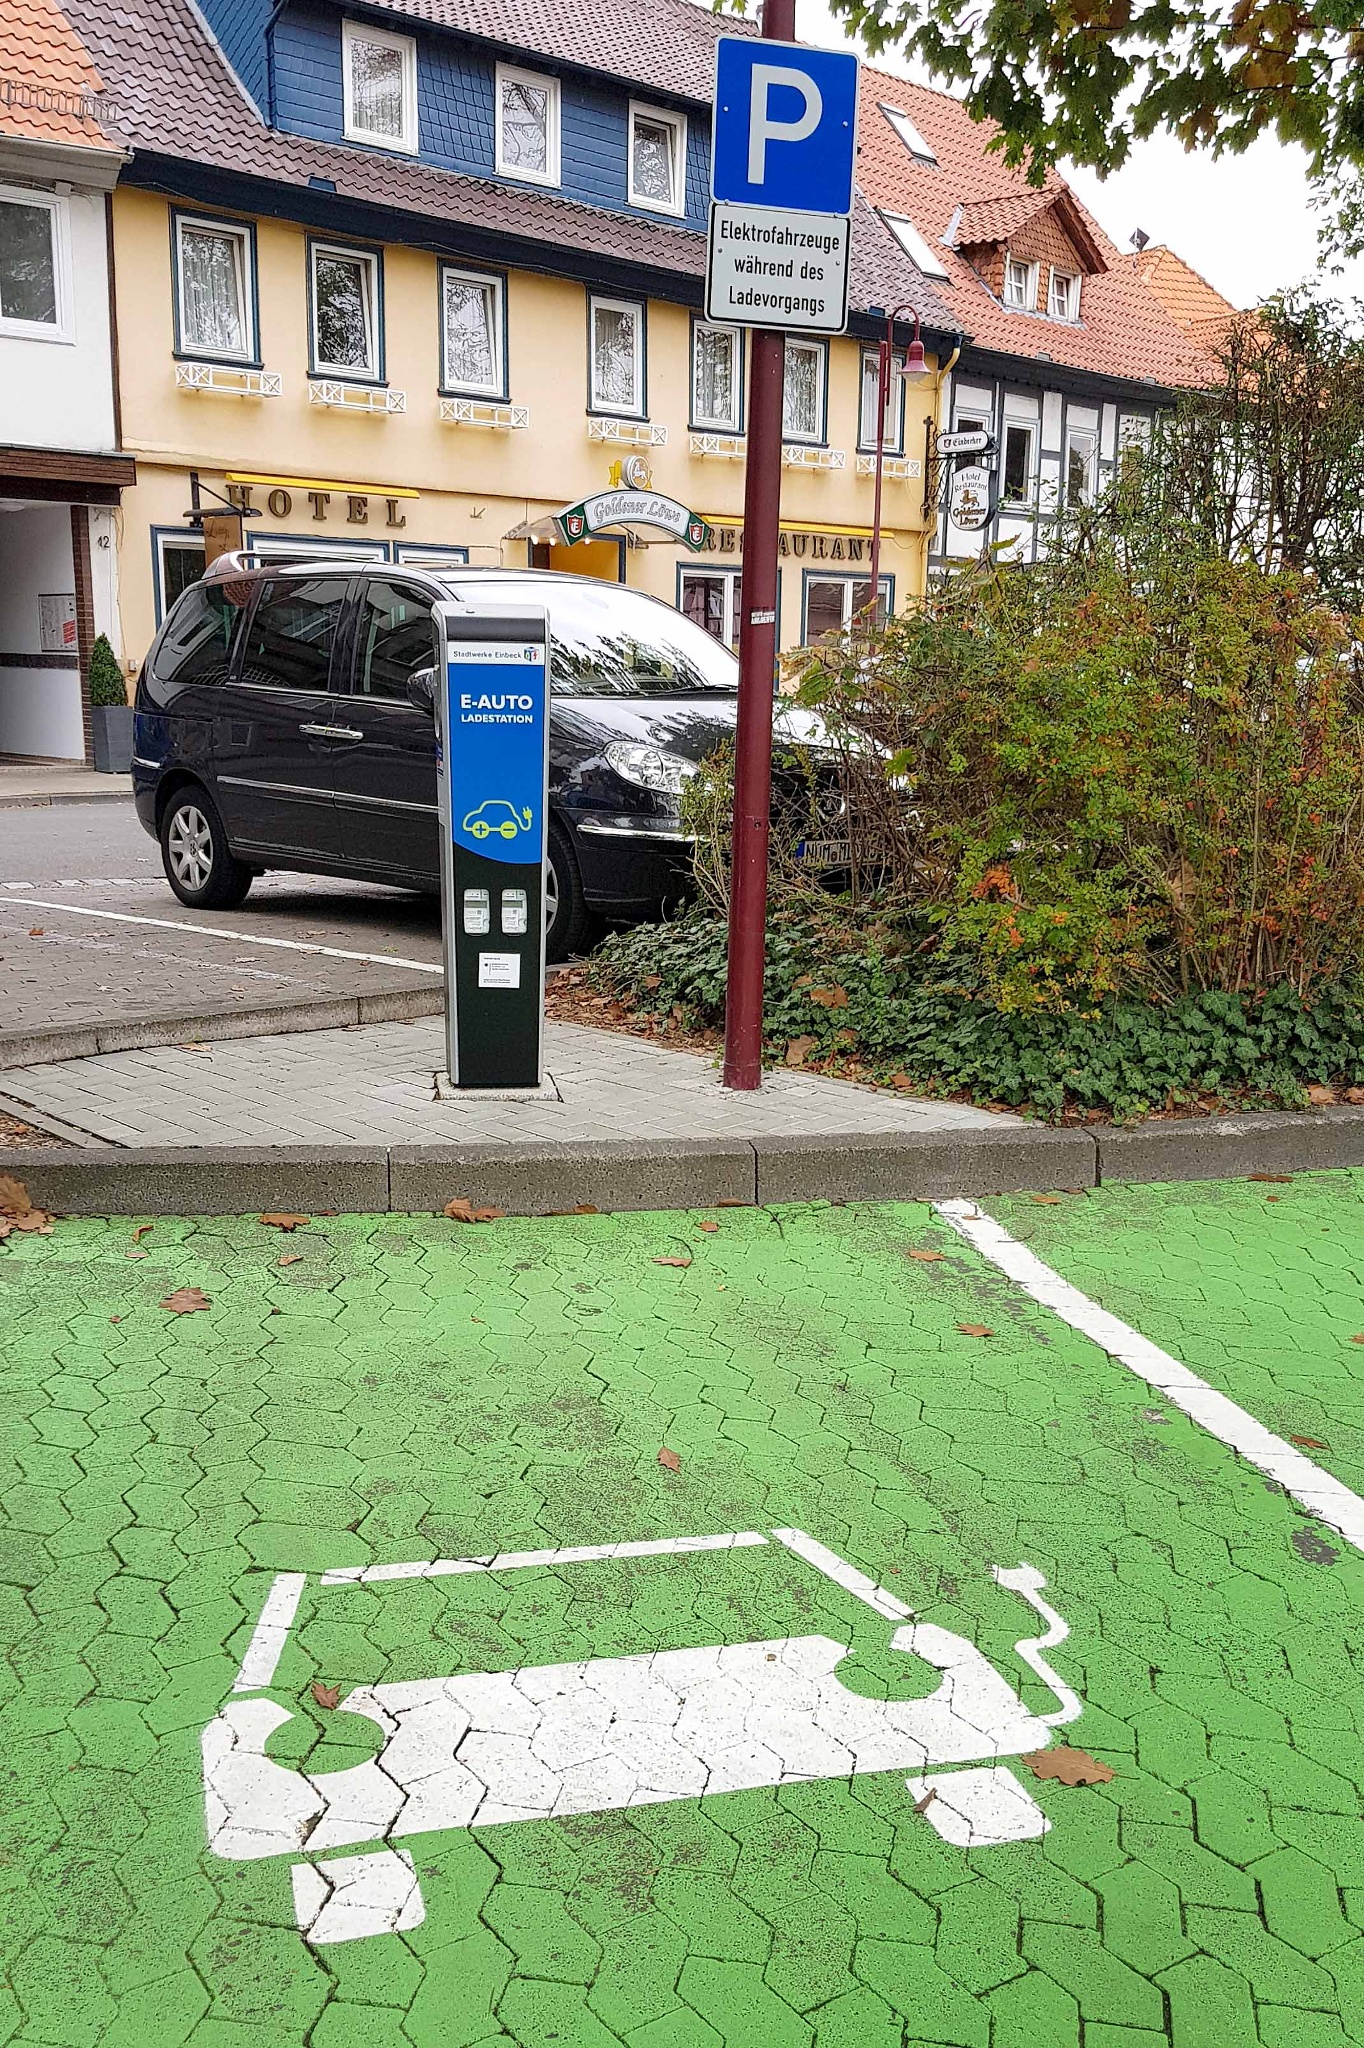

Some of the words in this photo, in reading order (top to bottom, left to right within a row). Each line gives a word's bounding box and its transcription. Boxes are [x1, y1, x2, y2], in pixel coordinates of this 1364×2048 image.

[748, 63, 823, 185] P
[720, 219, 840, 255] Elektrofahrzeuge
[734, 255, 793, 279] während
[800, 261, 824, 281] des
[729, 286, 825, 316] Ladevorgangs
[961, 473, 981, 481] Hotel
[955, 481, 987, 493] Restaurant
[225, 484, 407, 528] HOTEL
[594, 496, 647, 524] Goldener
[647, 500, 682, 523] Löwe
[953, 507, 986, 517] Goldener
[97, 535, 110, 549] 12
[453, 650, 492, 658] Stadtwerke
[495, 651, 521, 659] Einbeck
[460, 693, 533, 710] E-AUTO
[461, 713, 533, 724] LADESTATION
